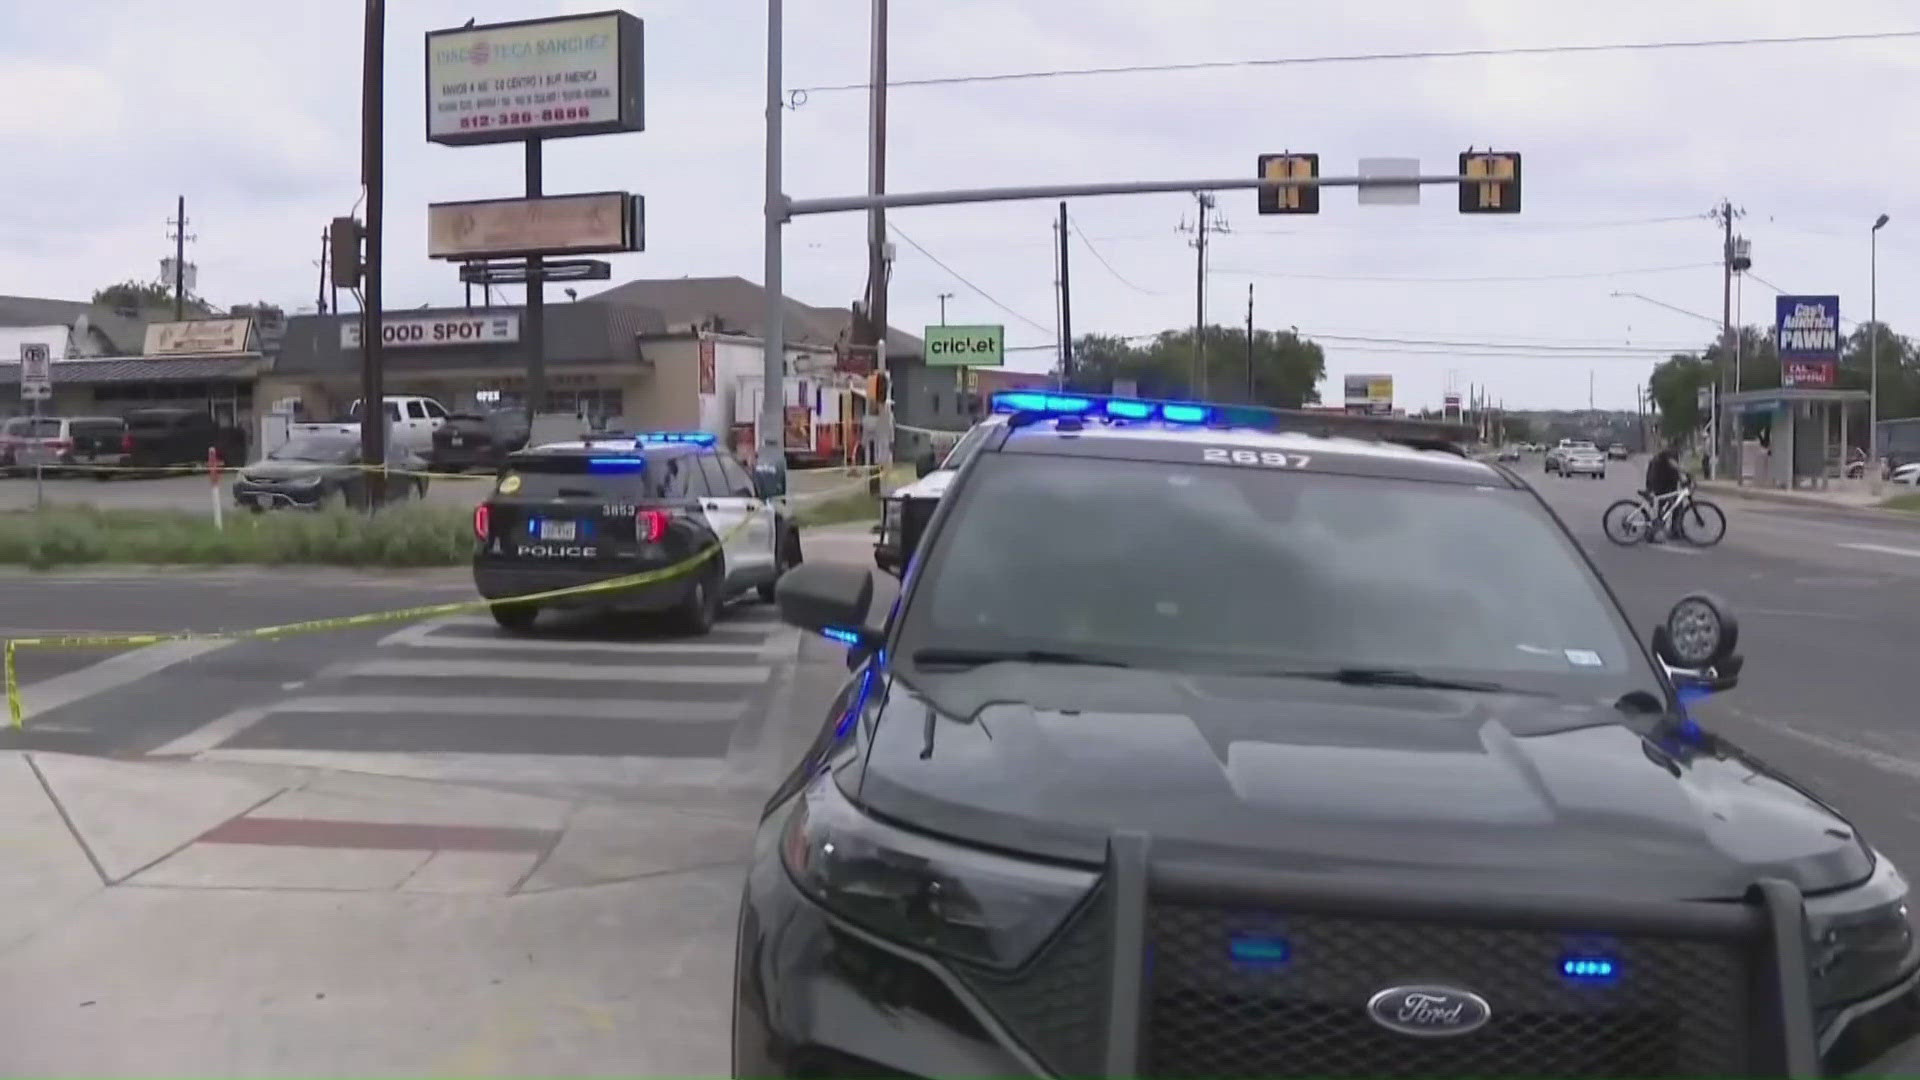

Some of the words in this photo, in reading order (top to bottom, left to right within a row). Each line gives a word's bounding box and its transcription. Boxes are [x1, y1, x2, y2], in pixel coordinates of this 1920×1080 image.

[383, 325, 423, 342] OOD
[434, 322, 483, 340] SPOT
[1781, 329, 1836, 351] PAWN
[931, 337, 995, 354] cricket
[1203, 449, 1312, 468] 2697
[518, 545, 598, 558] POLICE
[1399, 993, 1463, 1024] Ford
